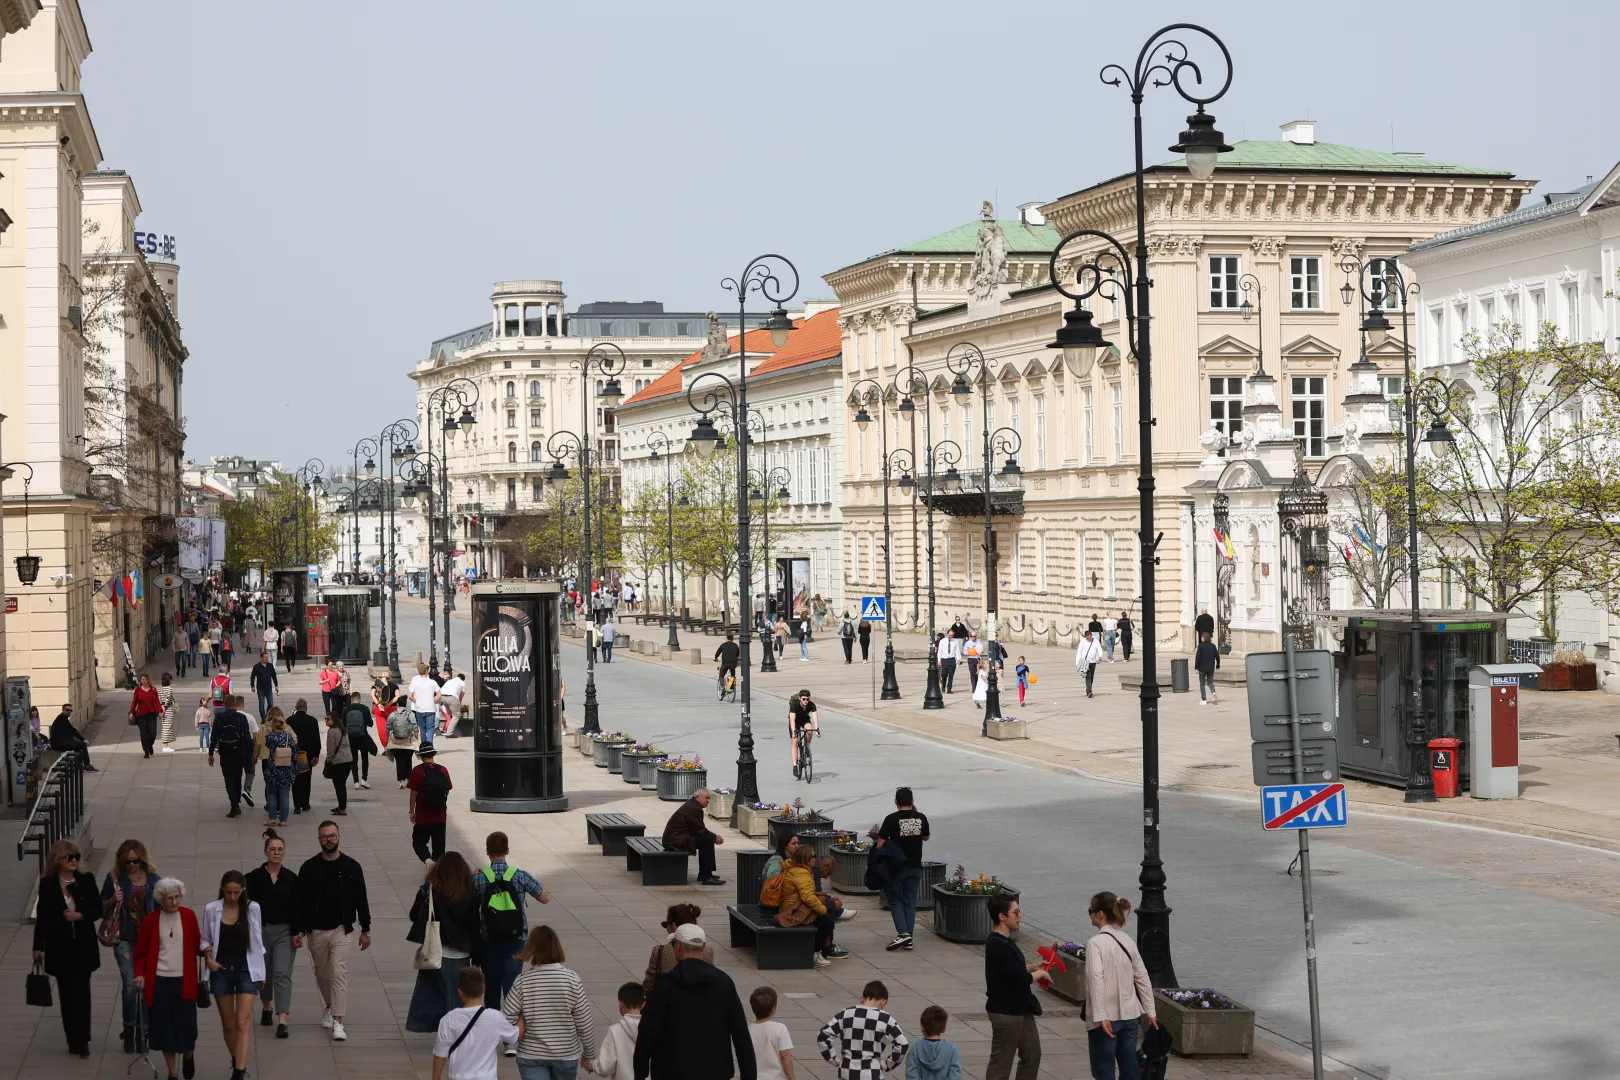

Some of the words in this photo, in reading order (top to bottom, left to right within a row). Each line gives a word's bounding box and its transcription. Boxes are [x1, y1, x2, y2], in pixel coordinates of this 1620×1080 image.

[483, 636, 518, 653] JULIA
[476, 655, 531, 673] KEILOWA
[1266, 789, 1344, 823] TAXI
